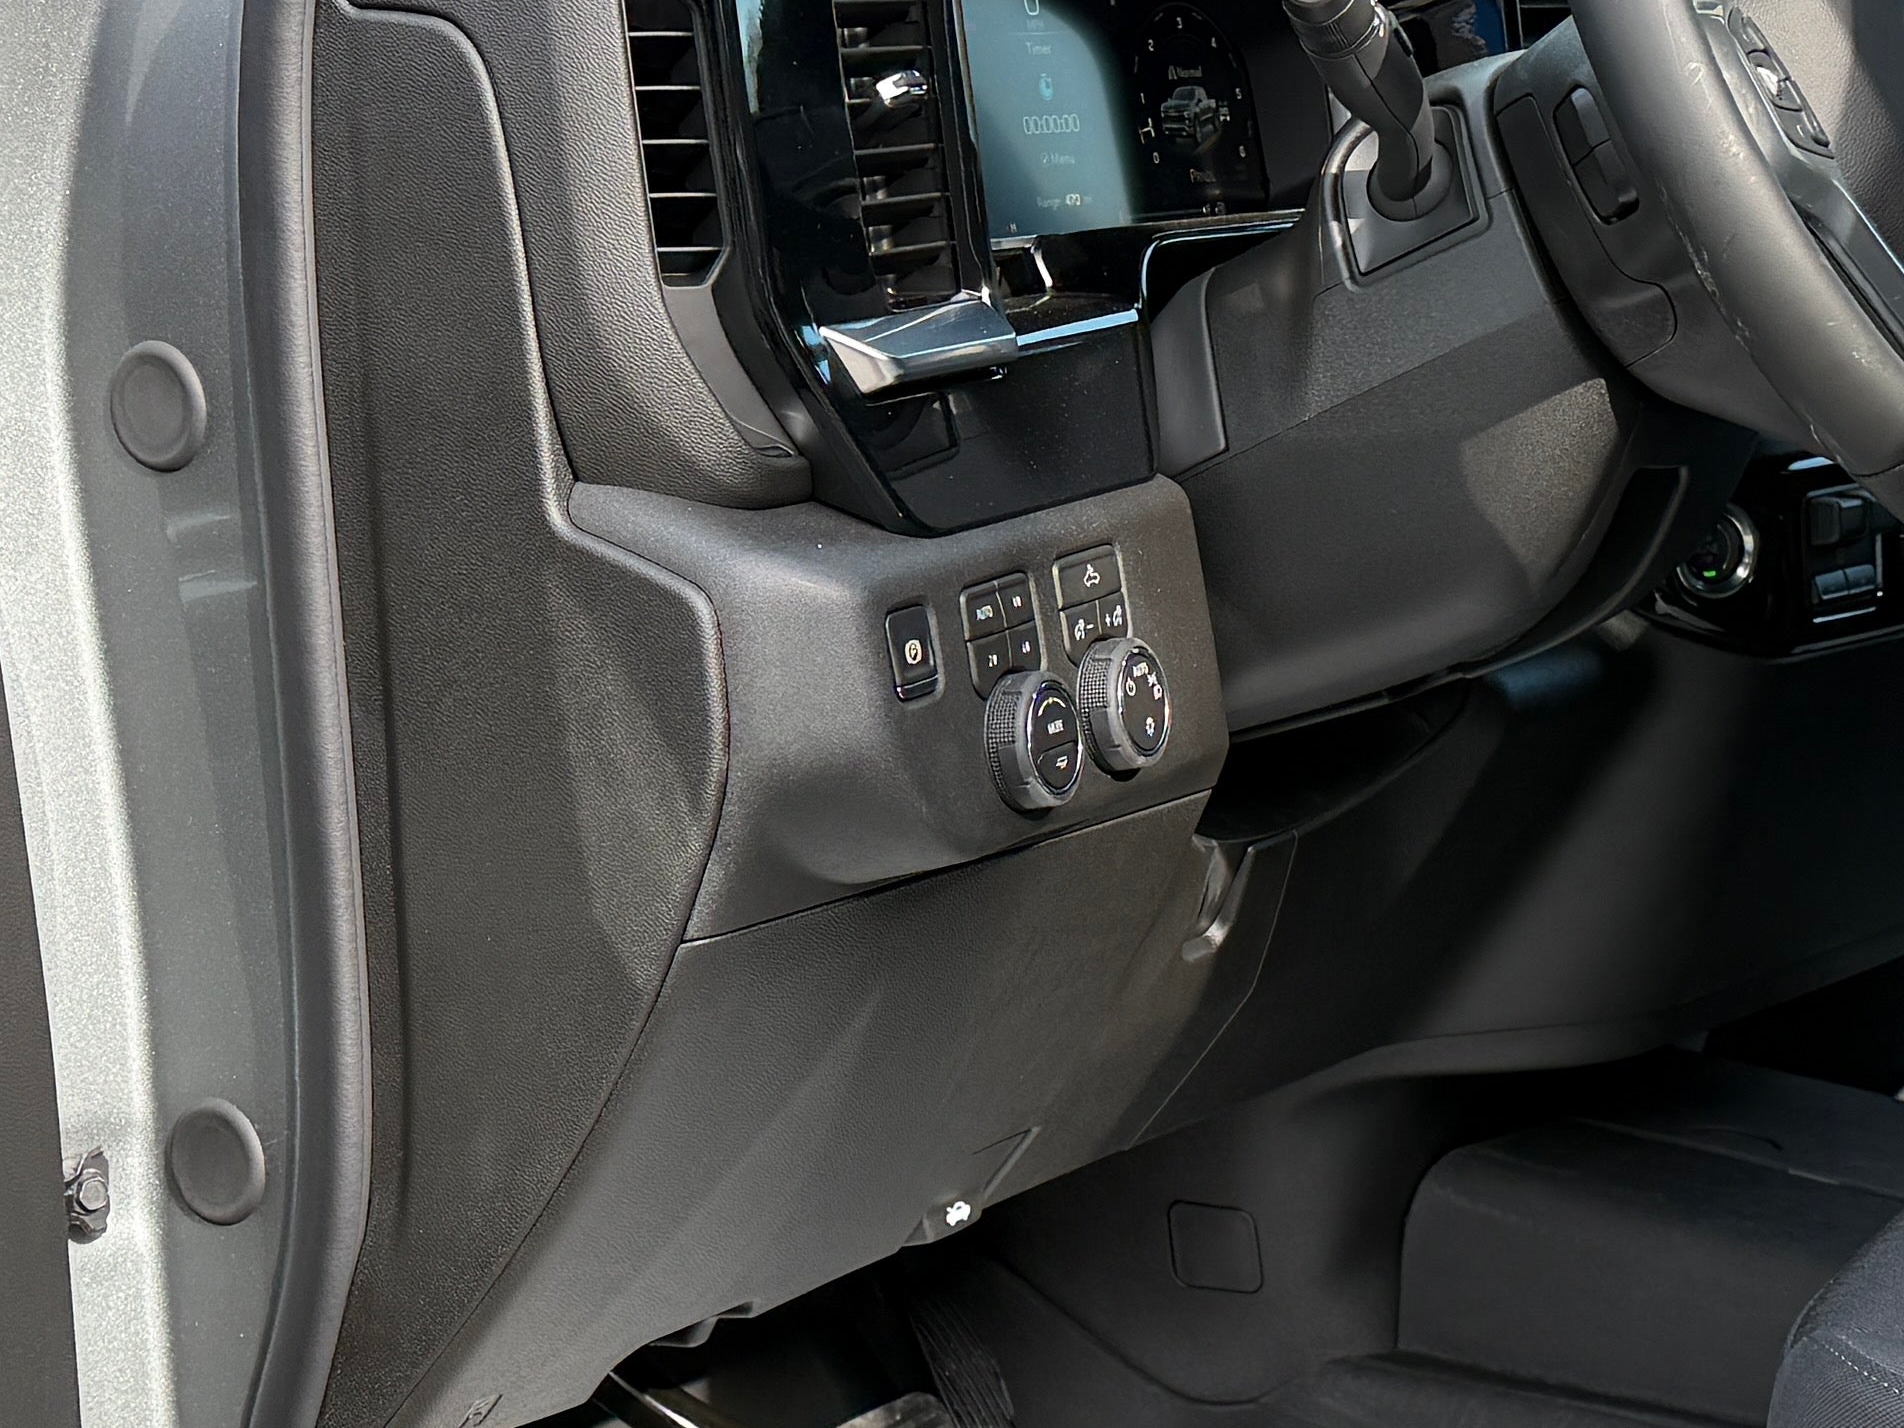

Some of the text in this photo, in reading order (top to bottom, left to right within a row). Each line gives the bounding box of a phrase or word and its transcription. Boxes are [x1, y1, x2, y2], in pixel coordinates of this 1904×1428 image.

[1026, 41, 1052, 55] Timer
[1147, 38, 1155, 52] 2
[1210, 36, 1217, 48] 4
[1023, 113, 1081, 135] 00:00:00
